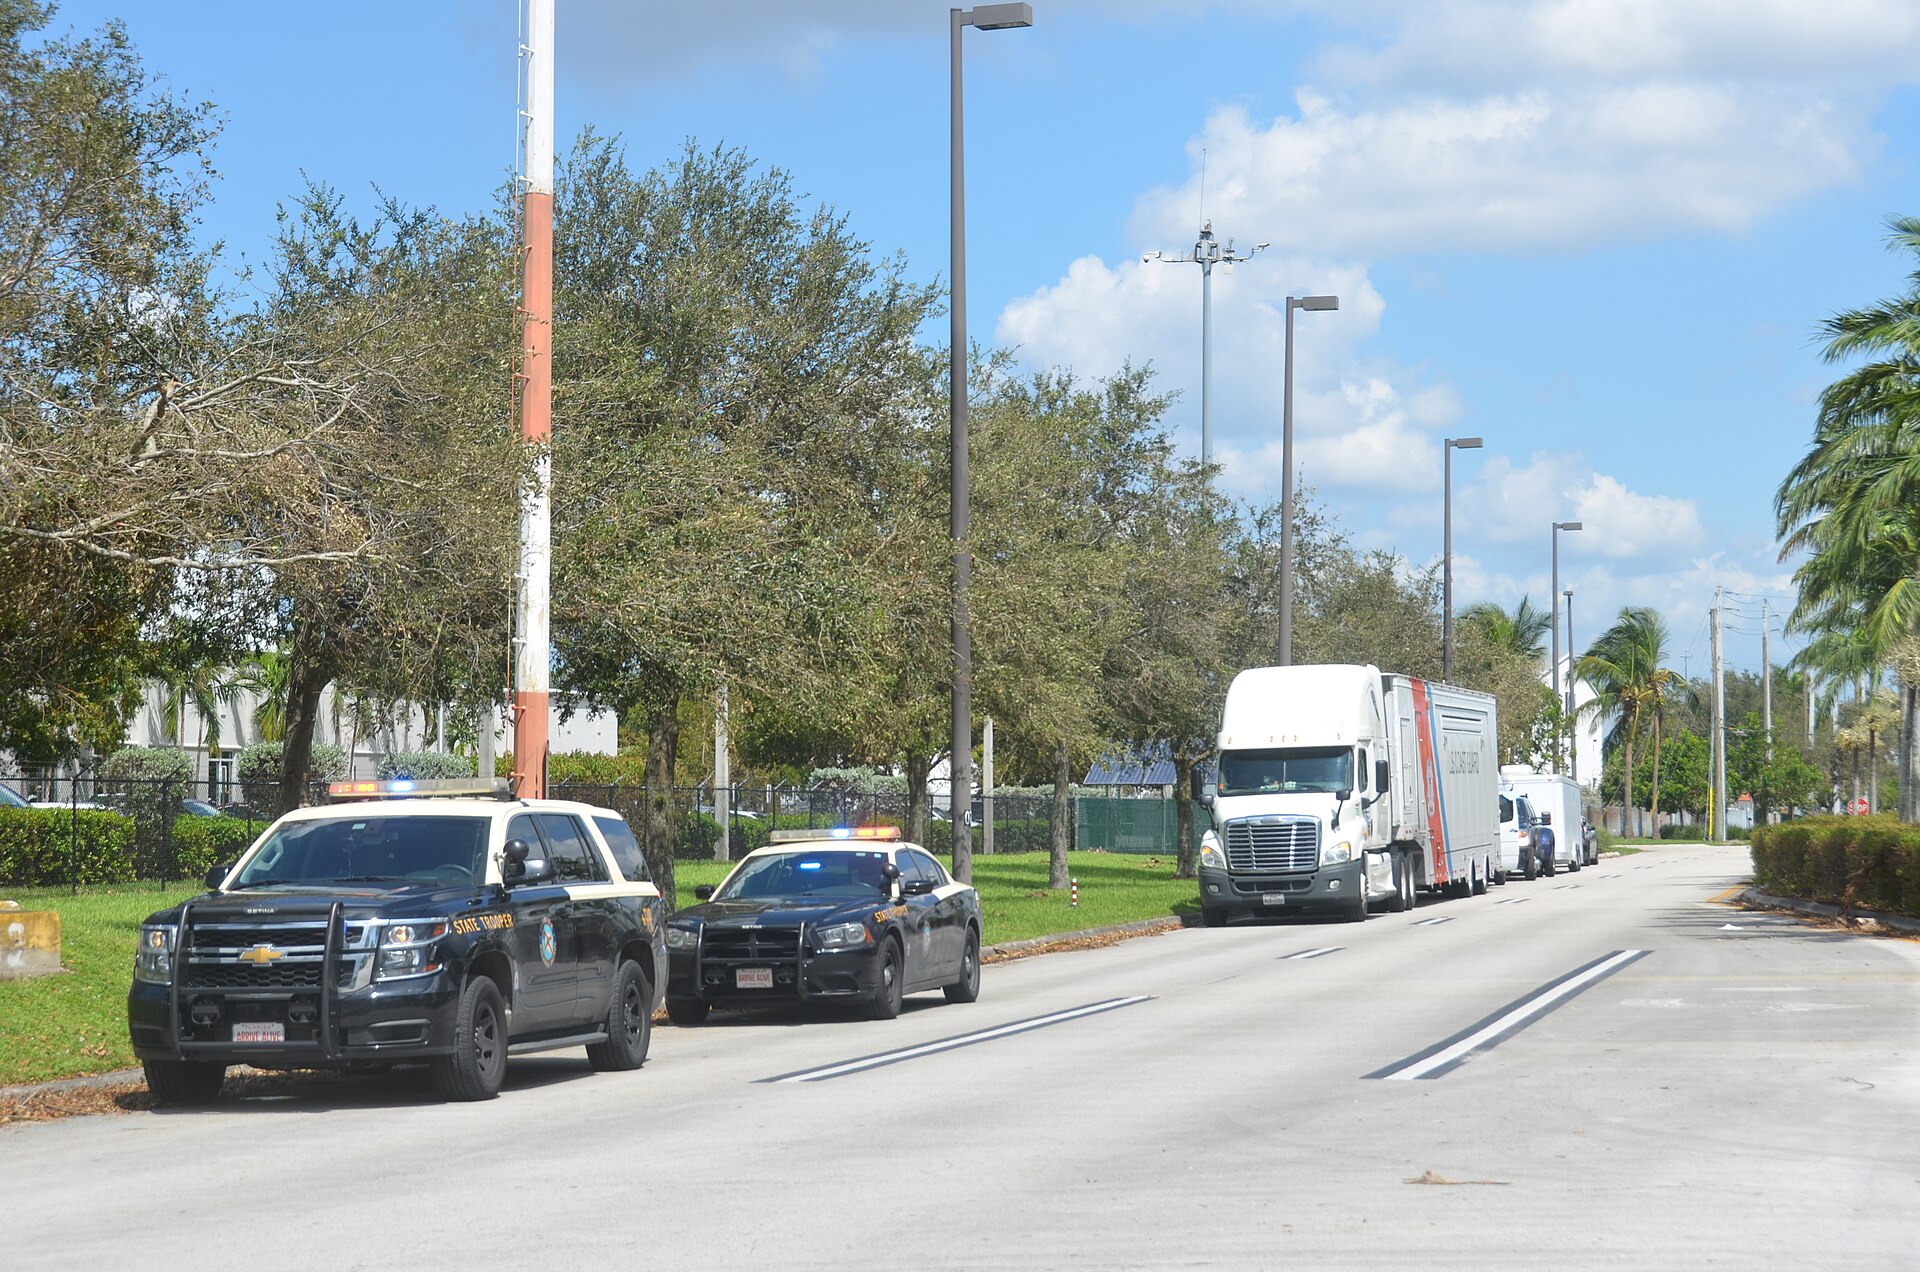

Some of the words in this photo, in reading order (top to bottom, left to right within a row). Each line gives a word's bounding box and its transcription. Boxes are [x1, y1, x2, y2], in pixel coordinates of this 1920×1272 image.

[1849, 803, 1867, 812] SOP
[453, 917, 481, 935] STATE
[479, 913, 514, 930] TROOPER
[237, 1031, 258, 1041] ARRIVE
[262, 1031, 281, 1041] ALIVE
